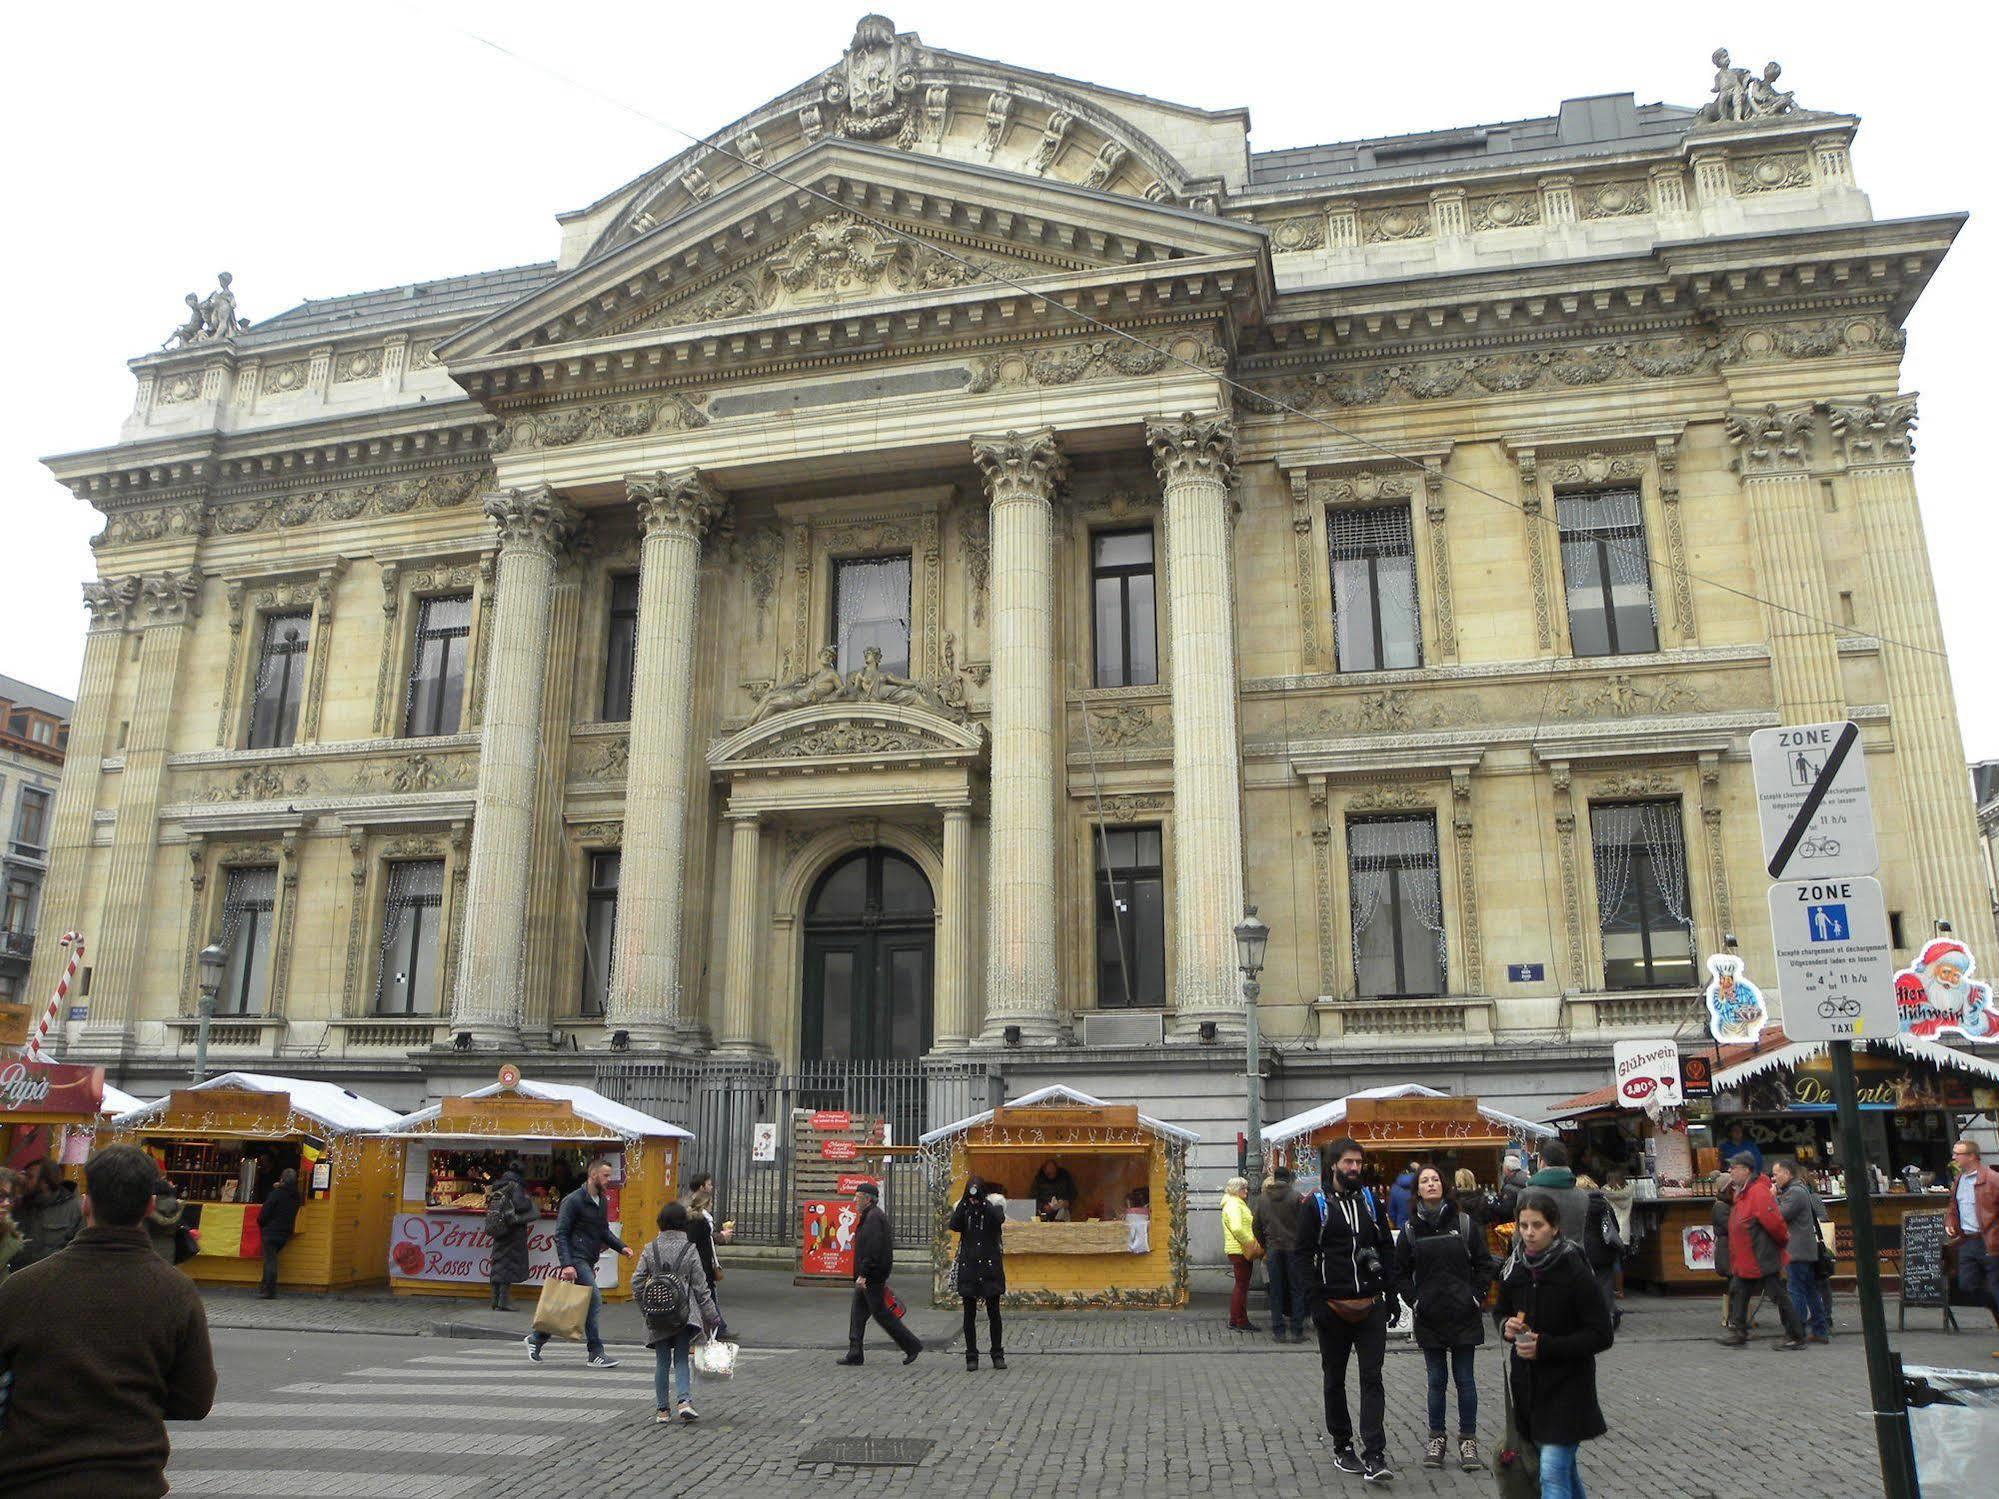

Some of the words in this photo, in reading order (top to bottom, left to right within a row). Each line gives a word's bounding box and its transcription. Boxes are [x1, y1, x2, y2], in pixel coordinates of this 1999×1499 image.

[1779, 729, 1832, 748] ZONE
[1797, 884, 1852, 901] ZONE
[1801, 947, 1835, 957] chargement
[1790, 958, 1828, 967] Uitgezonderd
[1829, 957, 1846, 965] laden
[1818, 976, 1824, 984] 4
[1840, 974, 1847, 983] 11
[1852, 973, 1868, 983] h/u
[1831, 1023, 1854, 1034] TAXI
[1618, 1045, 1676, 1077] Glühwein
[1795, 1077, 1832, 1104] De
[424, 1250, 473, 1276] Roses
